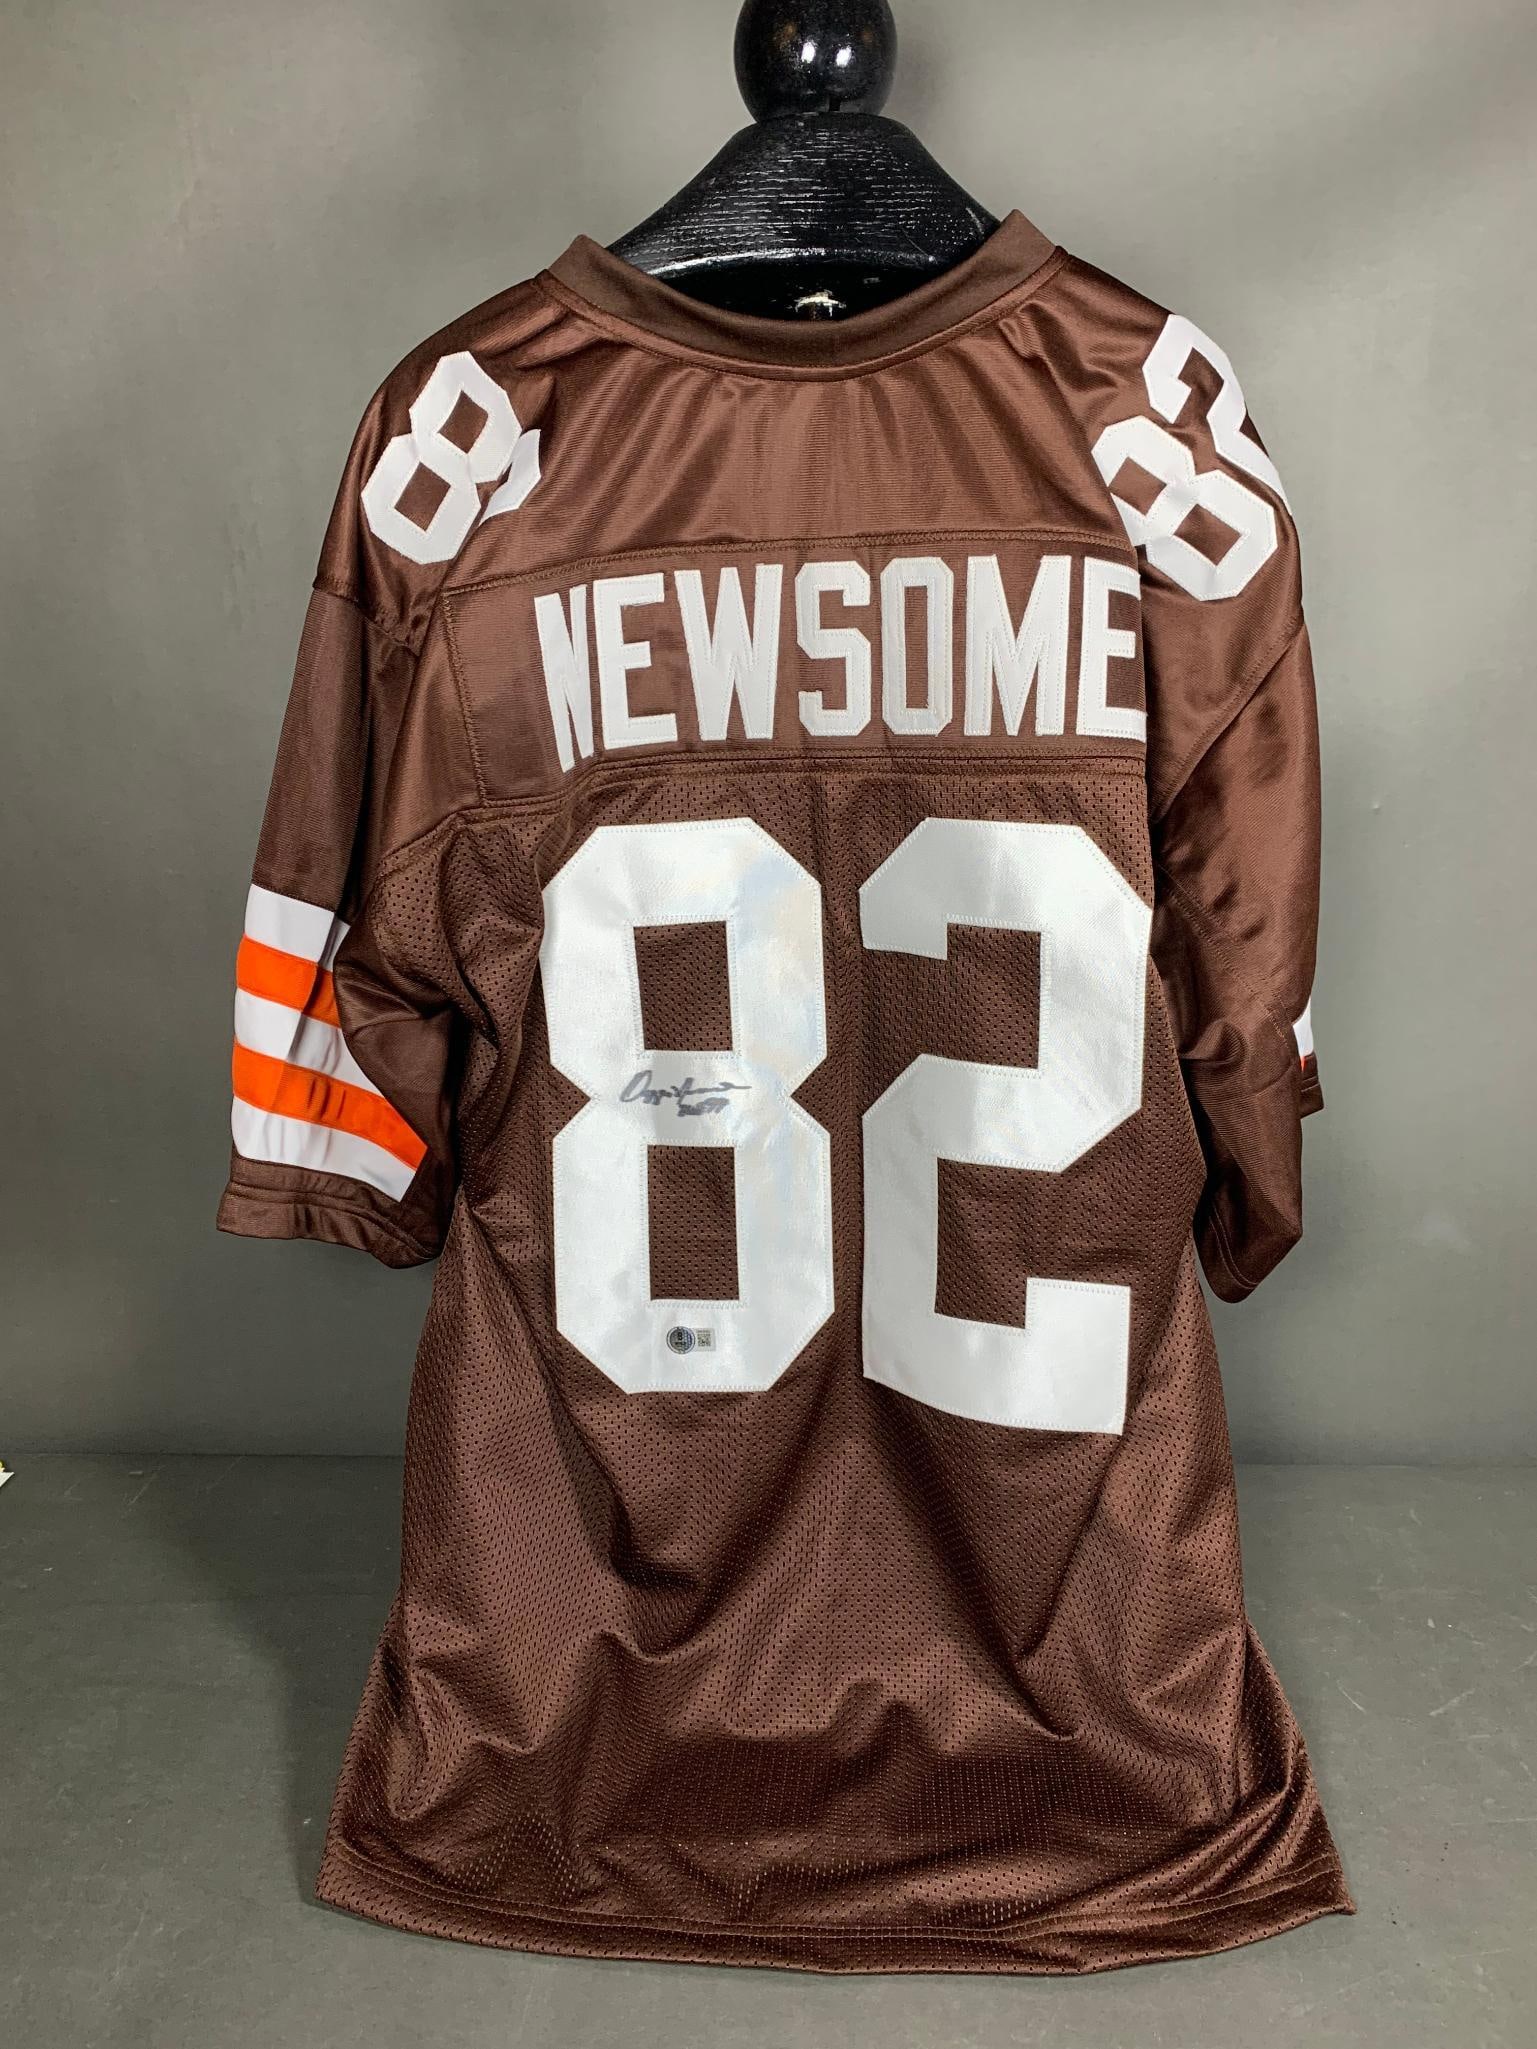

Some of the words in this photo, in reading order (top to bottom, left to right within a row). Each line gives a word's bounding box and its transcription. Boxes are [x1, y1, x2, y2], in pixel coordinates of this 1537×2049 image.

[1091, 314, 1292, 601] 82
[534, 555, 1147, 773] NEWSOME
[539, 817, 1152, 1435] 82
